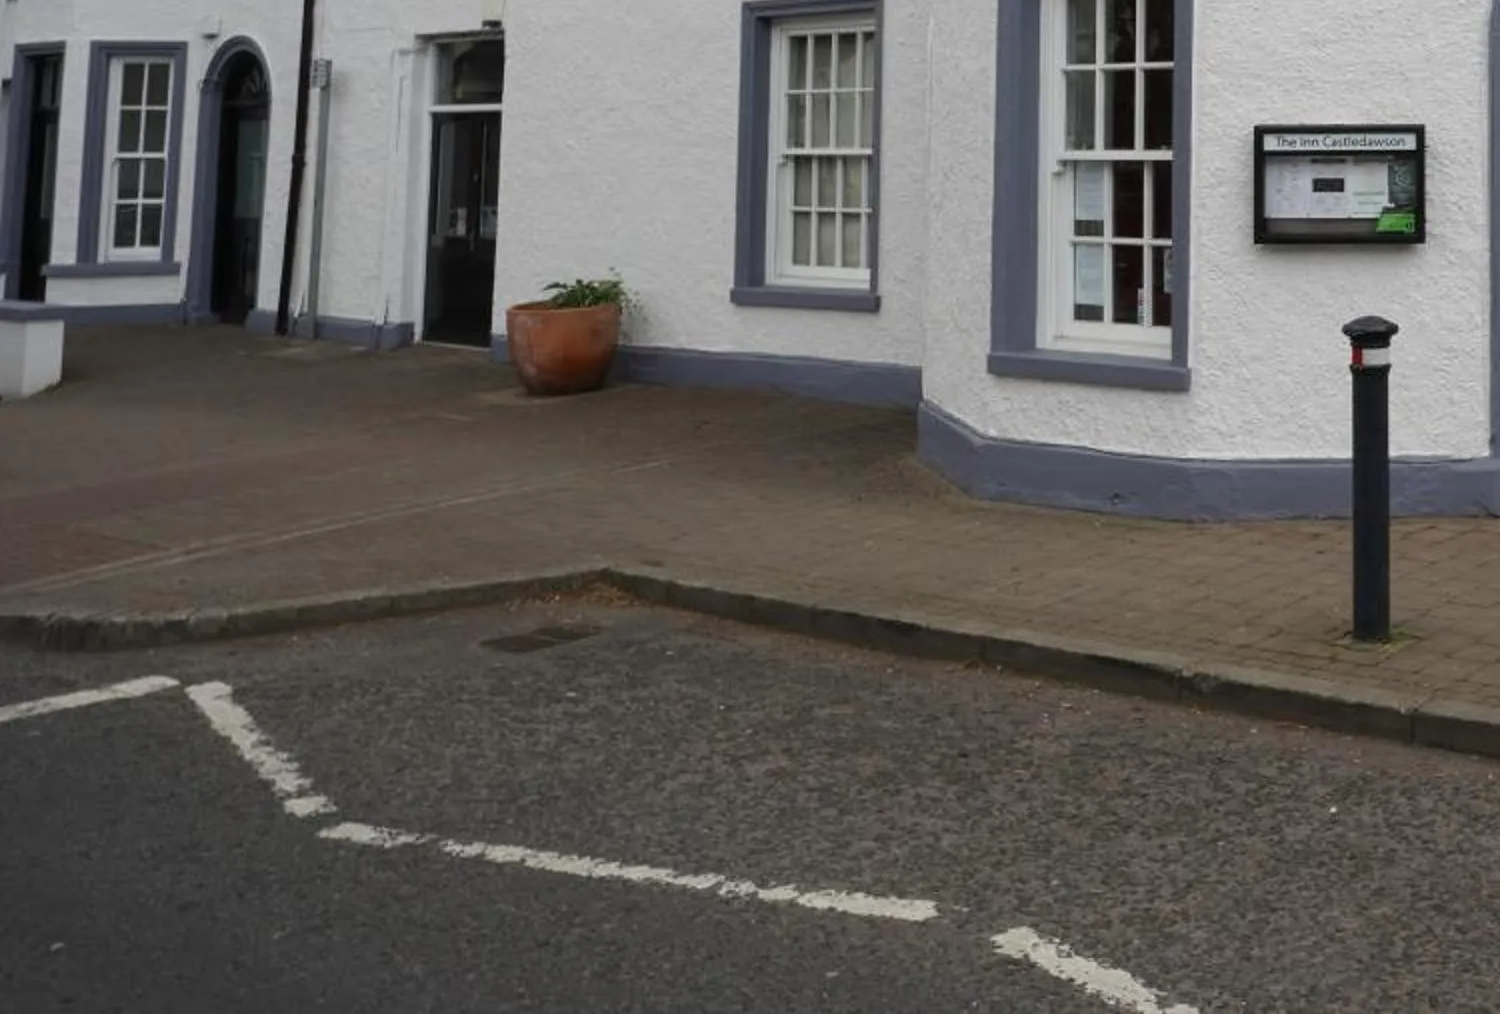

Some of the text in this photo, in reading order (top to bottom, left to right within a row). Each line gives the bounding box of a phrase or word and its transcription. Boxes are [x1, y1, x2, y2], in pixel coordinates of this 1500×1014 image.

[1276, 136, 1406, 148] The Inn Castledawson
